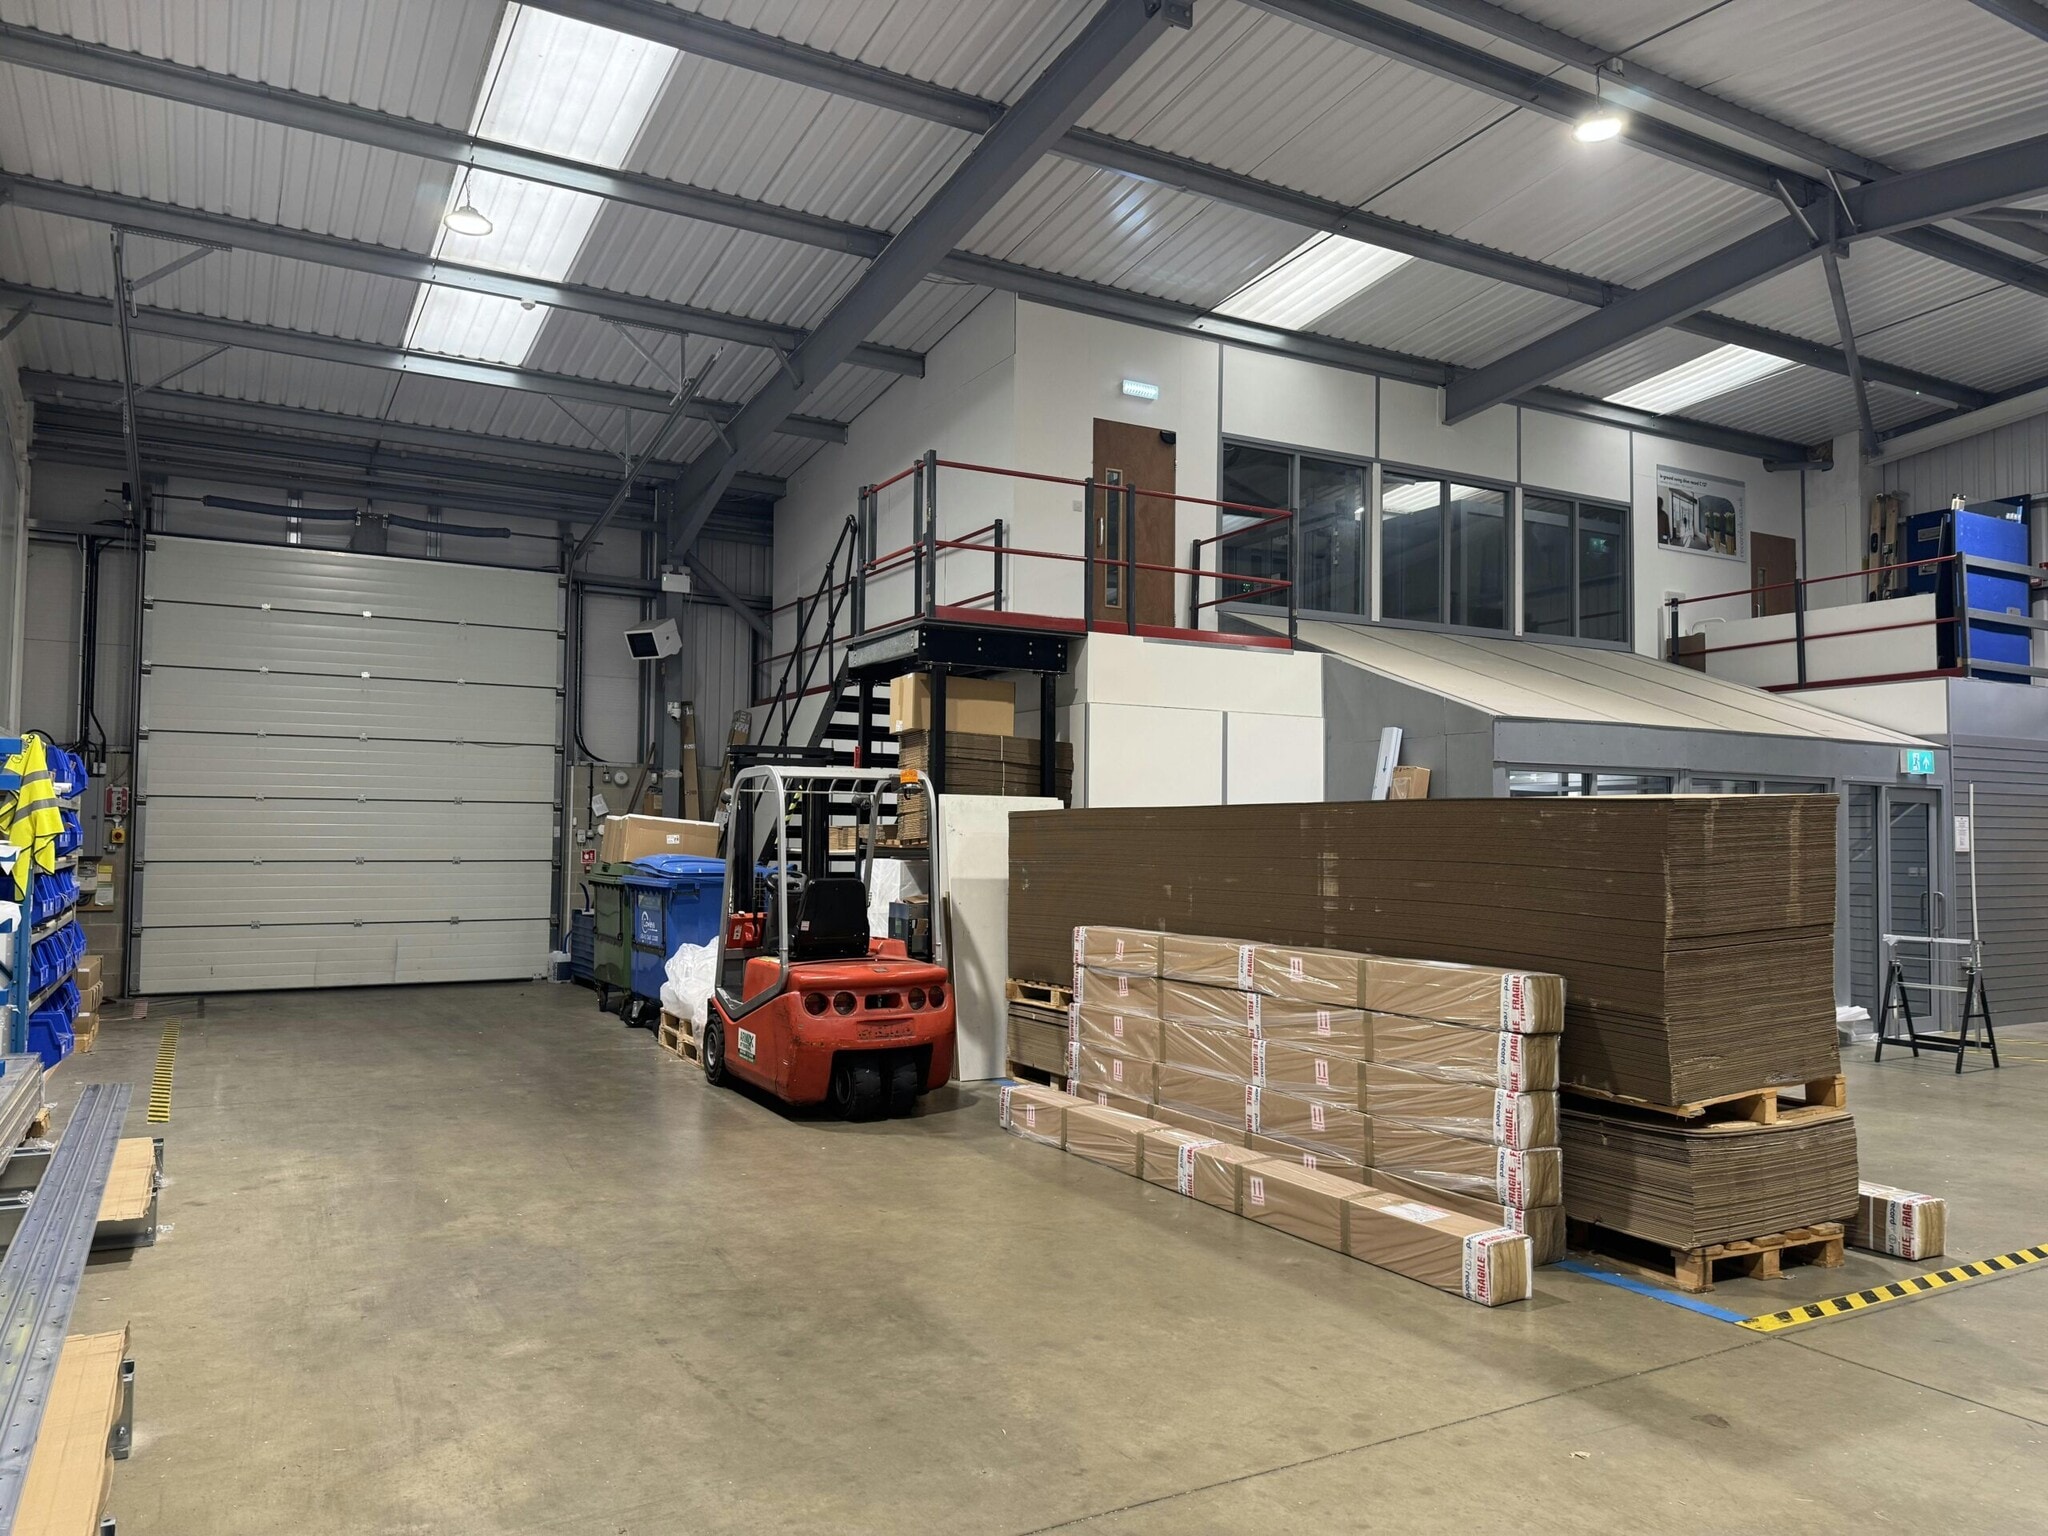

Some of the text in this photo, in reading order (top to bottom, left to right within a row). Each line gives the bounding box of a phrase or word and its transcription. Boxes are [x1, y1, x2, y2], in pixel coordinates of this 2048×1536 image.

[1510, 1034, 1518, 1063] FRAGI
[1505, 1108, 1513, 1146] FRAGILE
[1508, 1167, 1516, 1204] FRAGILE
[1902, 1203, 1912, 1228] FRAG
[1902, 1236, 1912, 1257] GILE
[1477, 1256, 1486, 1298] FRAGILE
